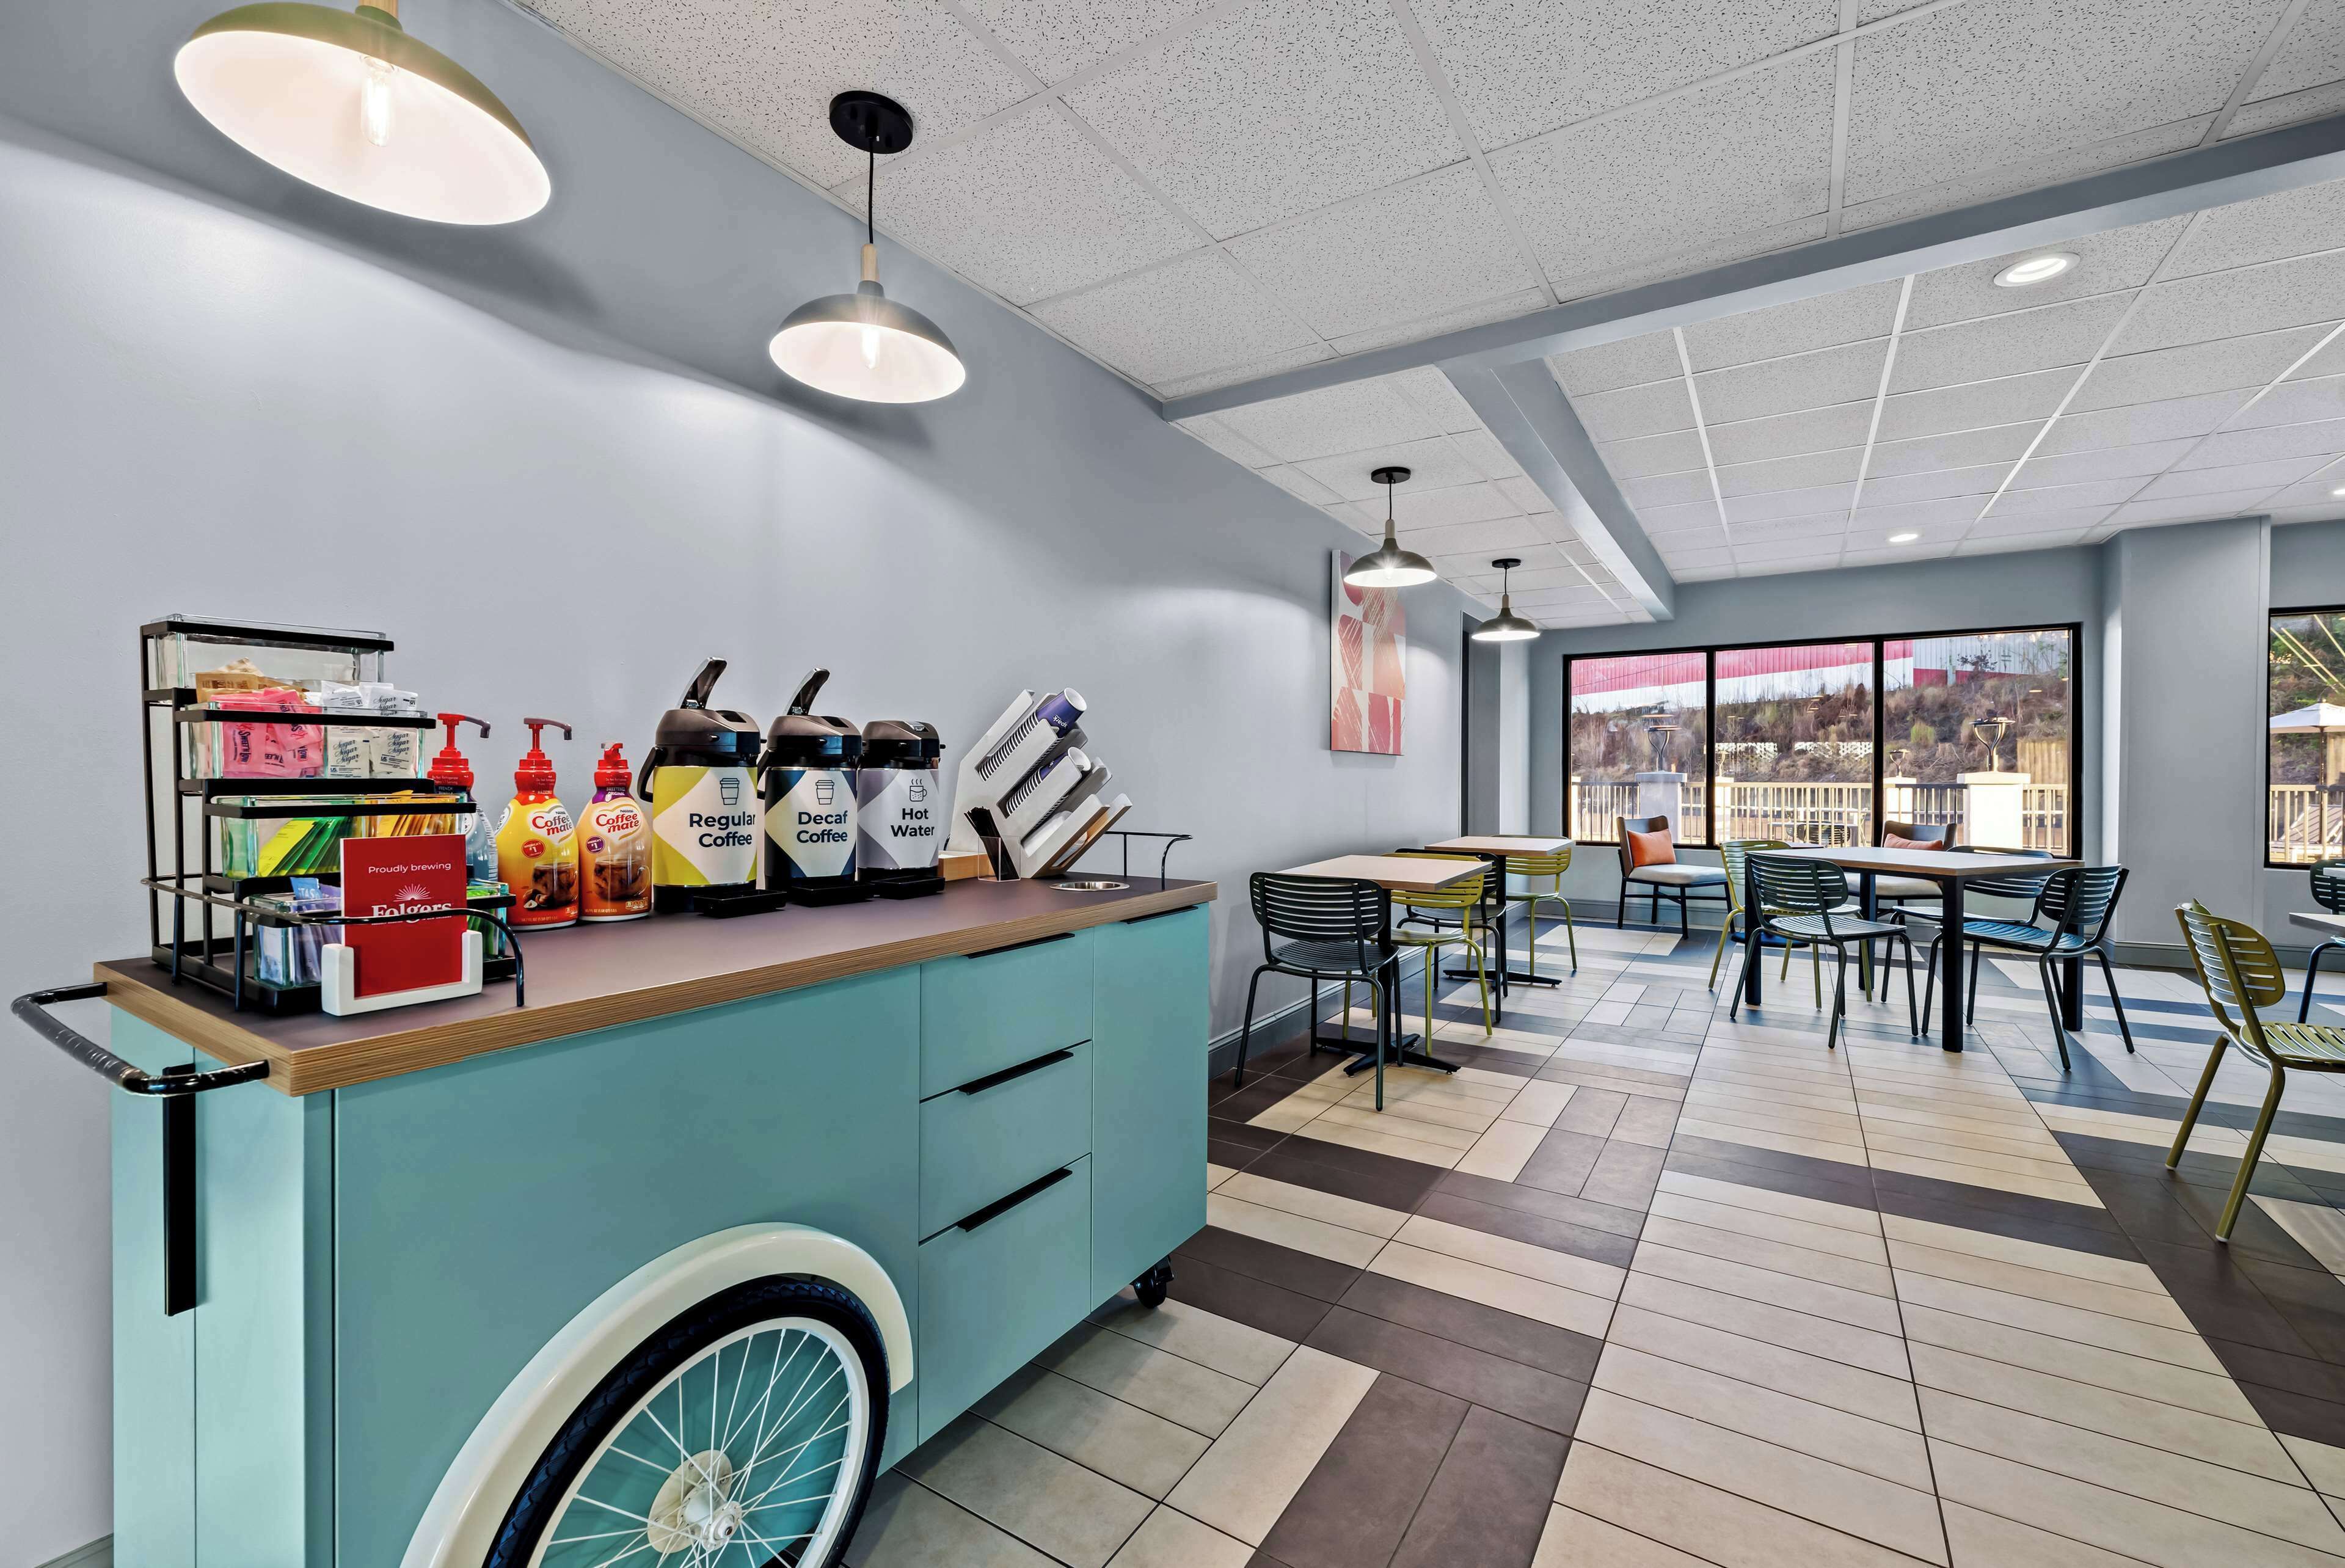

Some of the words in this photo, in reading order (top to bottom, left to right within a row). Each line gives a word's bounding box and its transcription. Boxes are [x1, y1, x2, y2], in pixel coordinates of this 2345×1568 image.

[1053, 716, 1068, 728] spark
[333, 740, 356, 750] Sugar
[388, 747, 410, 756] Sugar
[335, 747, 357, 757] Sugar
[337, 754, 359, 765] Sugar
[596, 813, 638, 826] Coffee
[689, 811, 756, 830] Regular
[798, 810, 848, 825] Decaf
[902, 808, 928, 820] Hot
[532, 815, 570, 829] Coffee
[607, 820, 640, 833] mate
[547, 822, 572, 836] mate
[891, 825, 935, 837] Water
[698, 831, 752, 848] Coffee
[797, 829, 848, 843] Coffee
[368, 864, 408, 873] Proudly
[371, 903, 452, 923] Folgers
